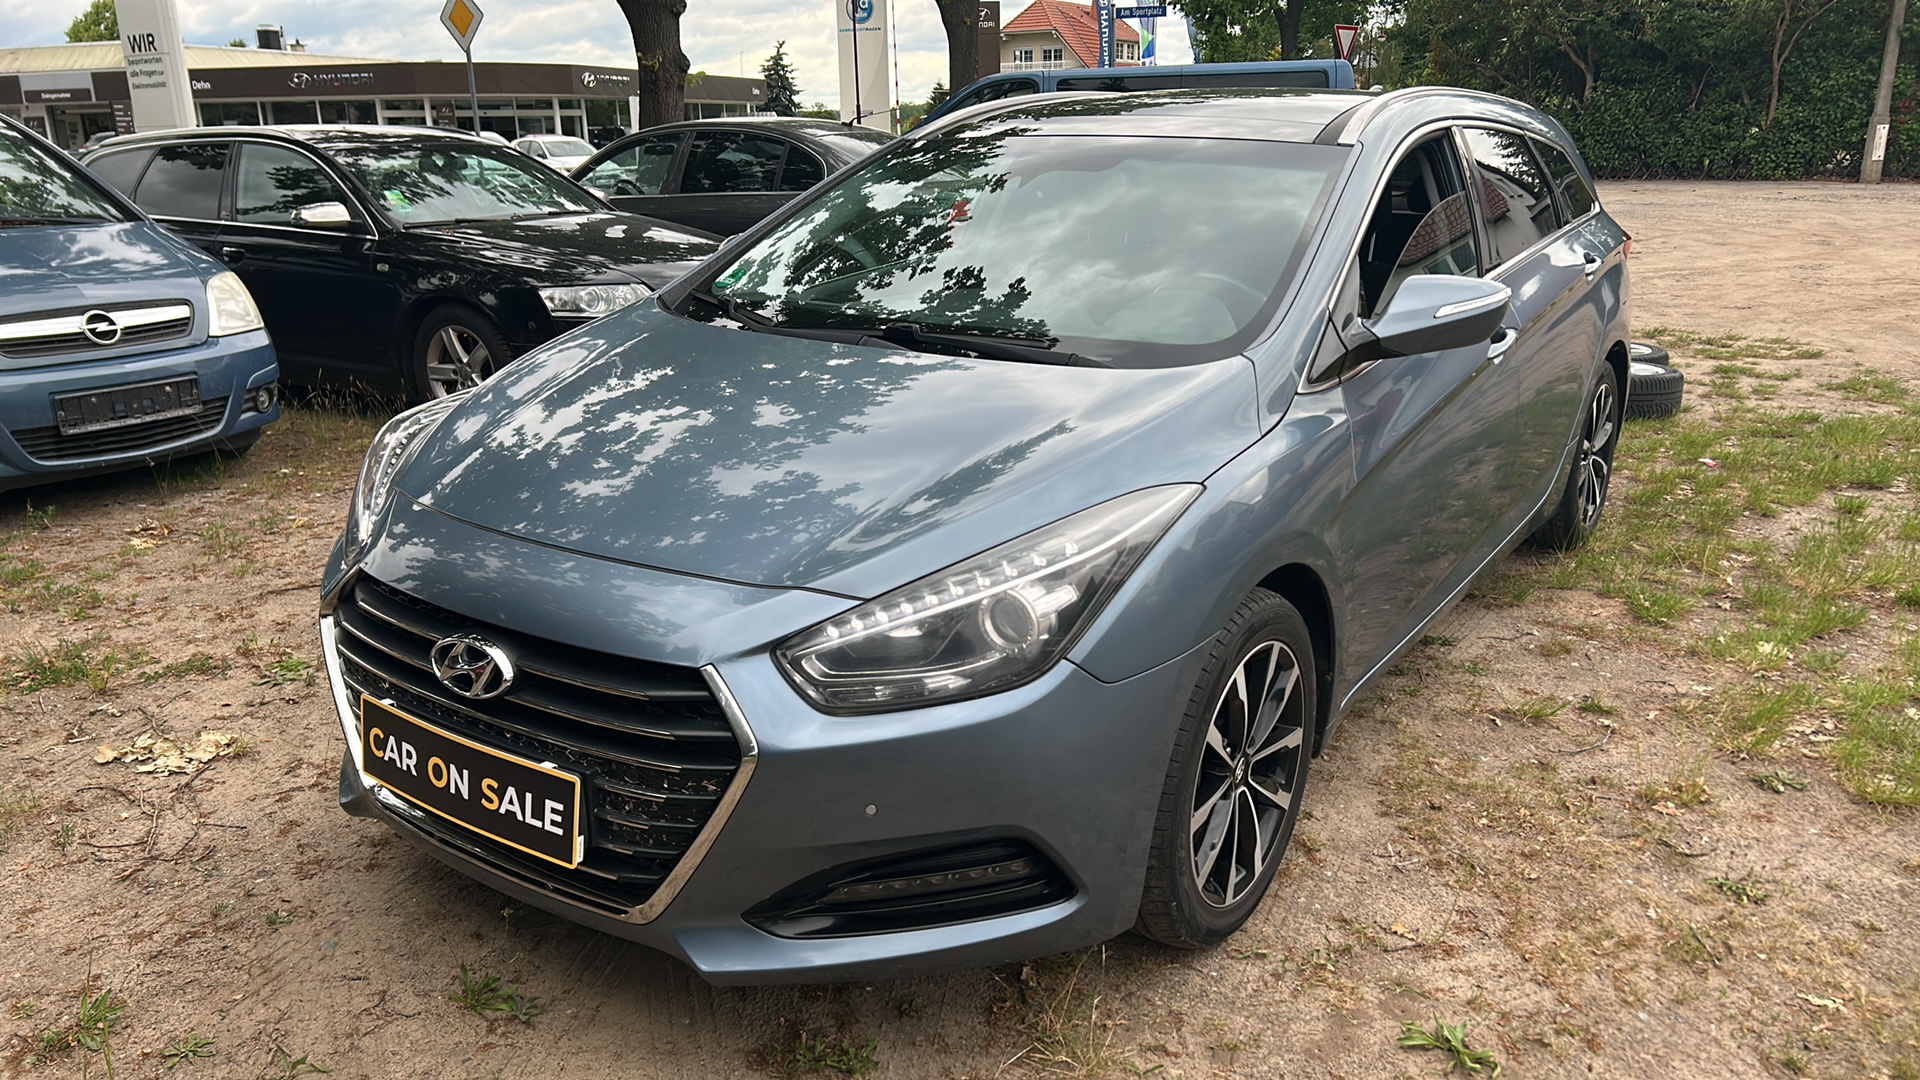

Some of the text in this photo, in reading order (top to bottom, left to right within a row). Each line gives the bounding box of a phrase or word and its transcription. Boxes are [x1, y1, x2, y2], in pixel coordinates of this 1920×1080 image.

[1132, 8, 1162, 16] Sportplatz
[127, 33, 157, 53] WIR
[1100, 10, 1109, 69] HYUNDAI
[127, 57, 163, 66] beantworten
[130, 70, 139, 78] alle
[140, 69, 157, 78] Fragen
[314, 72, 374, 86] HYUNDAI
[192, 80, 211, 90] Dehn
[369, 726, 564, 836] CAR ON SALE
